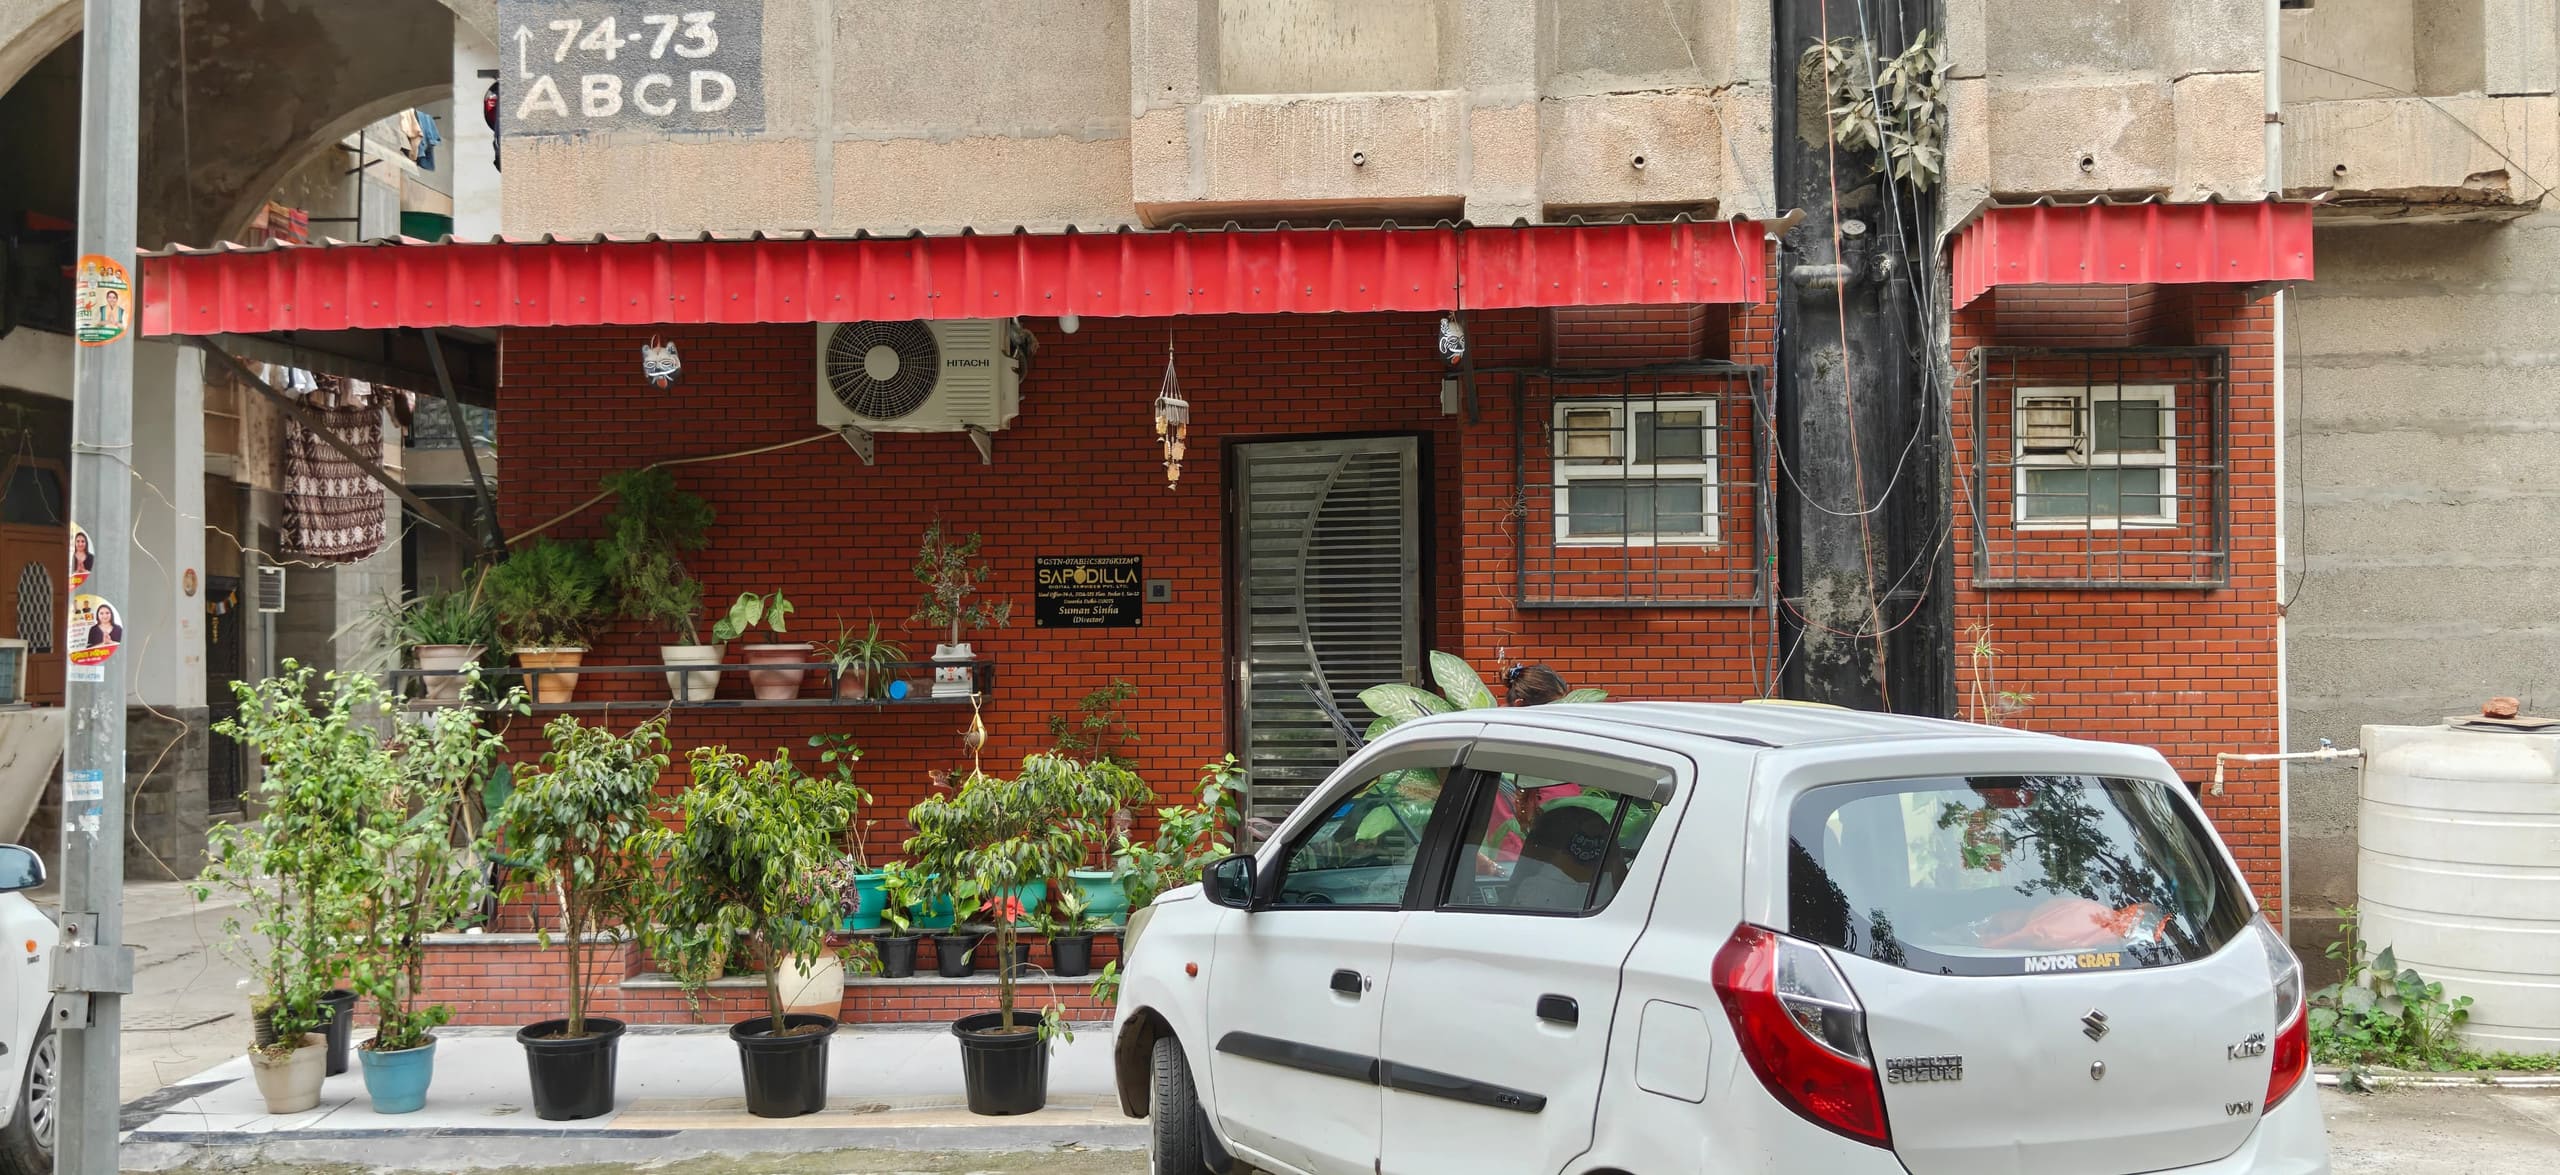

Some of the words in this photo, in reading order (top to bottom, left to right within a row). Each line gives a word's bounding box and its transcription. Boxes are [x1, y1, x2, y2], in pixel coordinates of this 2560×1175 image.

[549, 11, 719, 63] 74-73
[946, 359, 990, 367] HITACHI
[1058, 606, 1090, 615] Suman
[1092, 604, 1119, 615] Sinha
[1073, 615, 1105, 624] (Director)
[1887, 1067, 1962, 1084] SUZUKI
